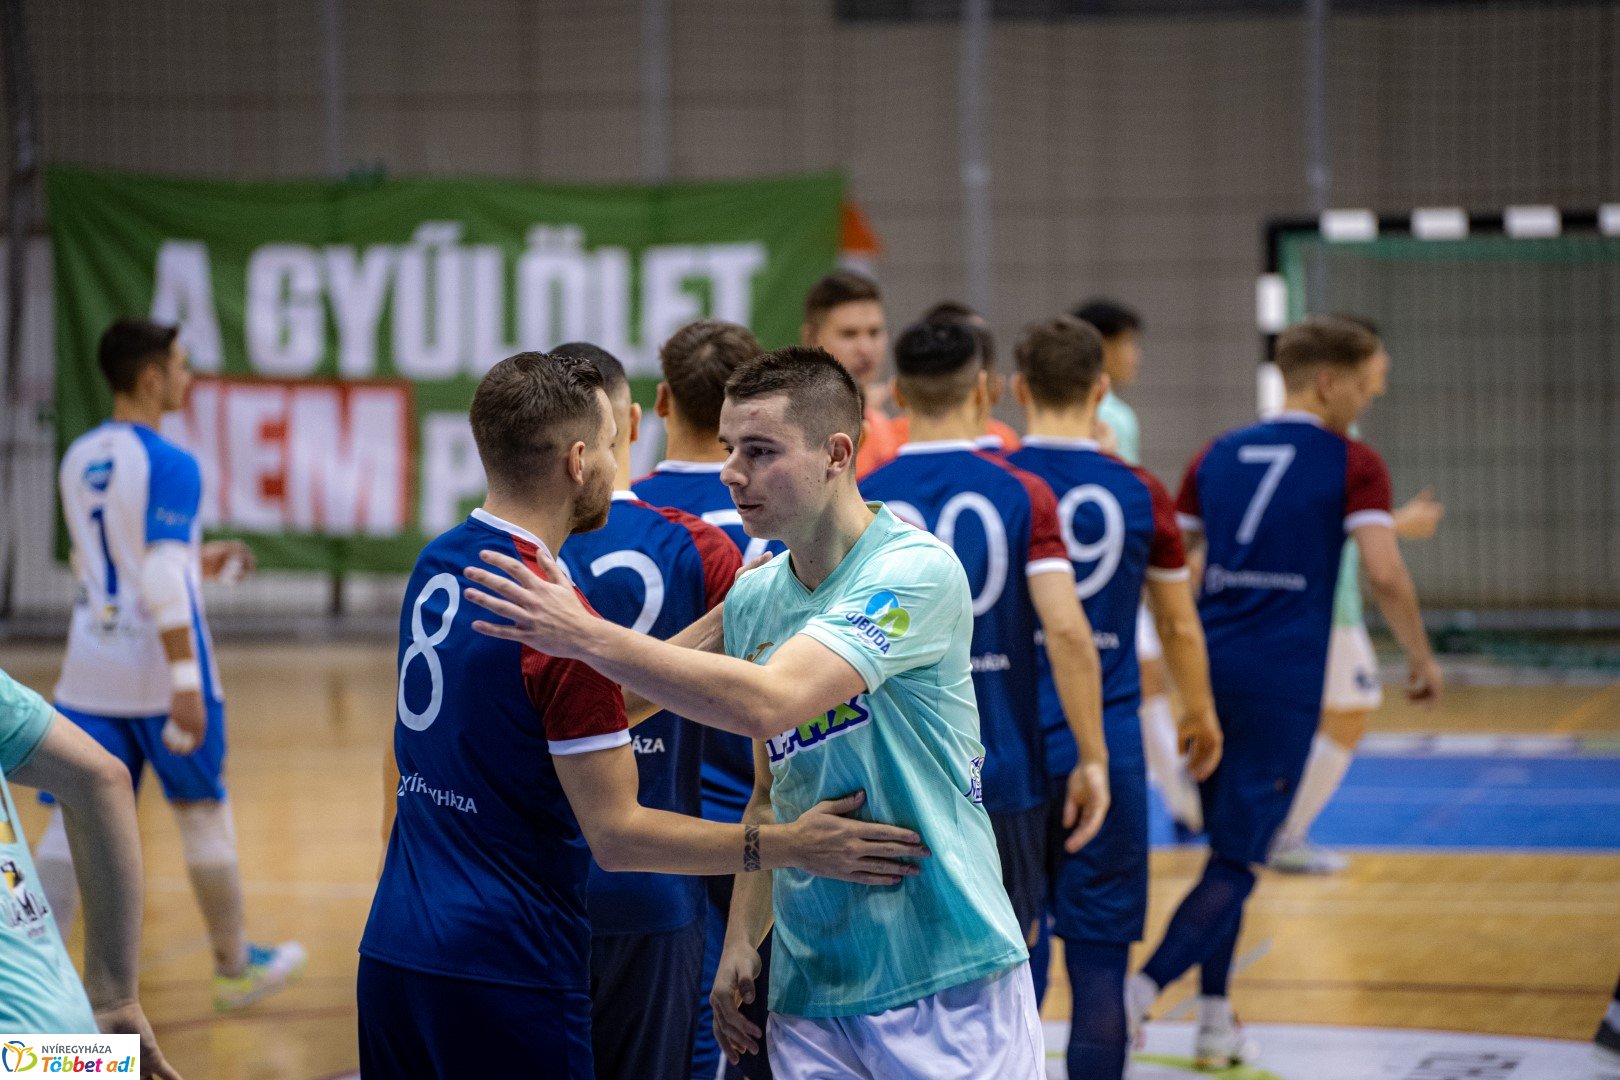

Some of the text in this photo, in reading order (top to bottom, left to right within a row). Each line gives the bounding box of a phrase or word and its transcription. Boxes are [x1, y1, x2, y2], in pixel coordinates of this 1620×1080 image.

[151, 219, 769, 380] A GYŰLÖLET
[90, 507, 118, 597] 1
[1056, 484, 1125, 600] 9
[1236, 445, 1298, 544] 7
[398, 573, 460, 732] 8
